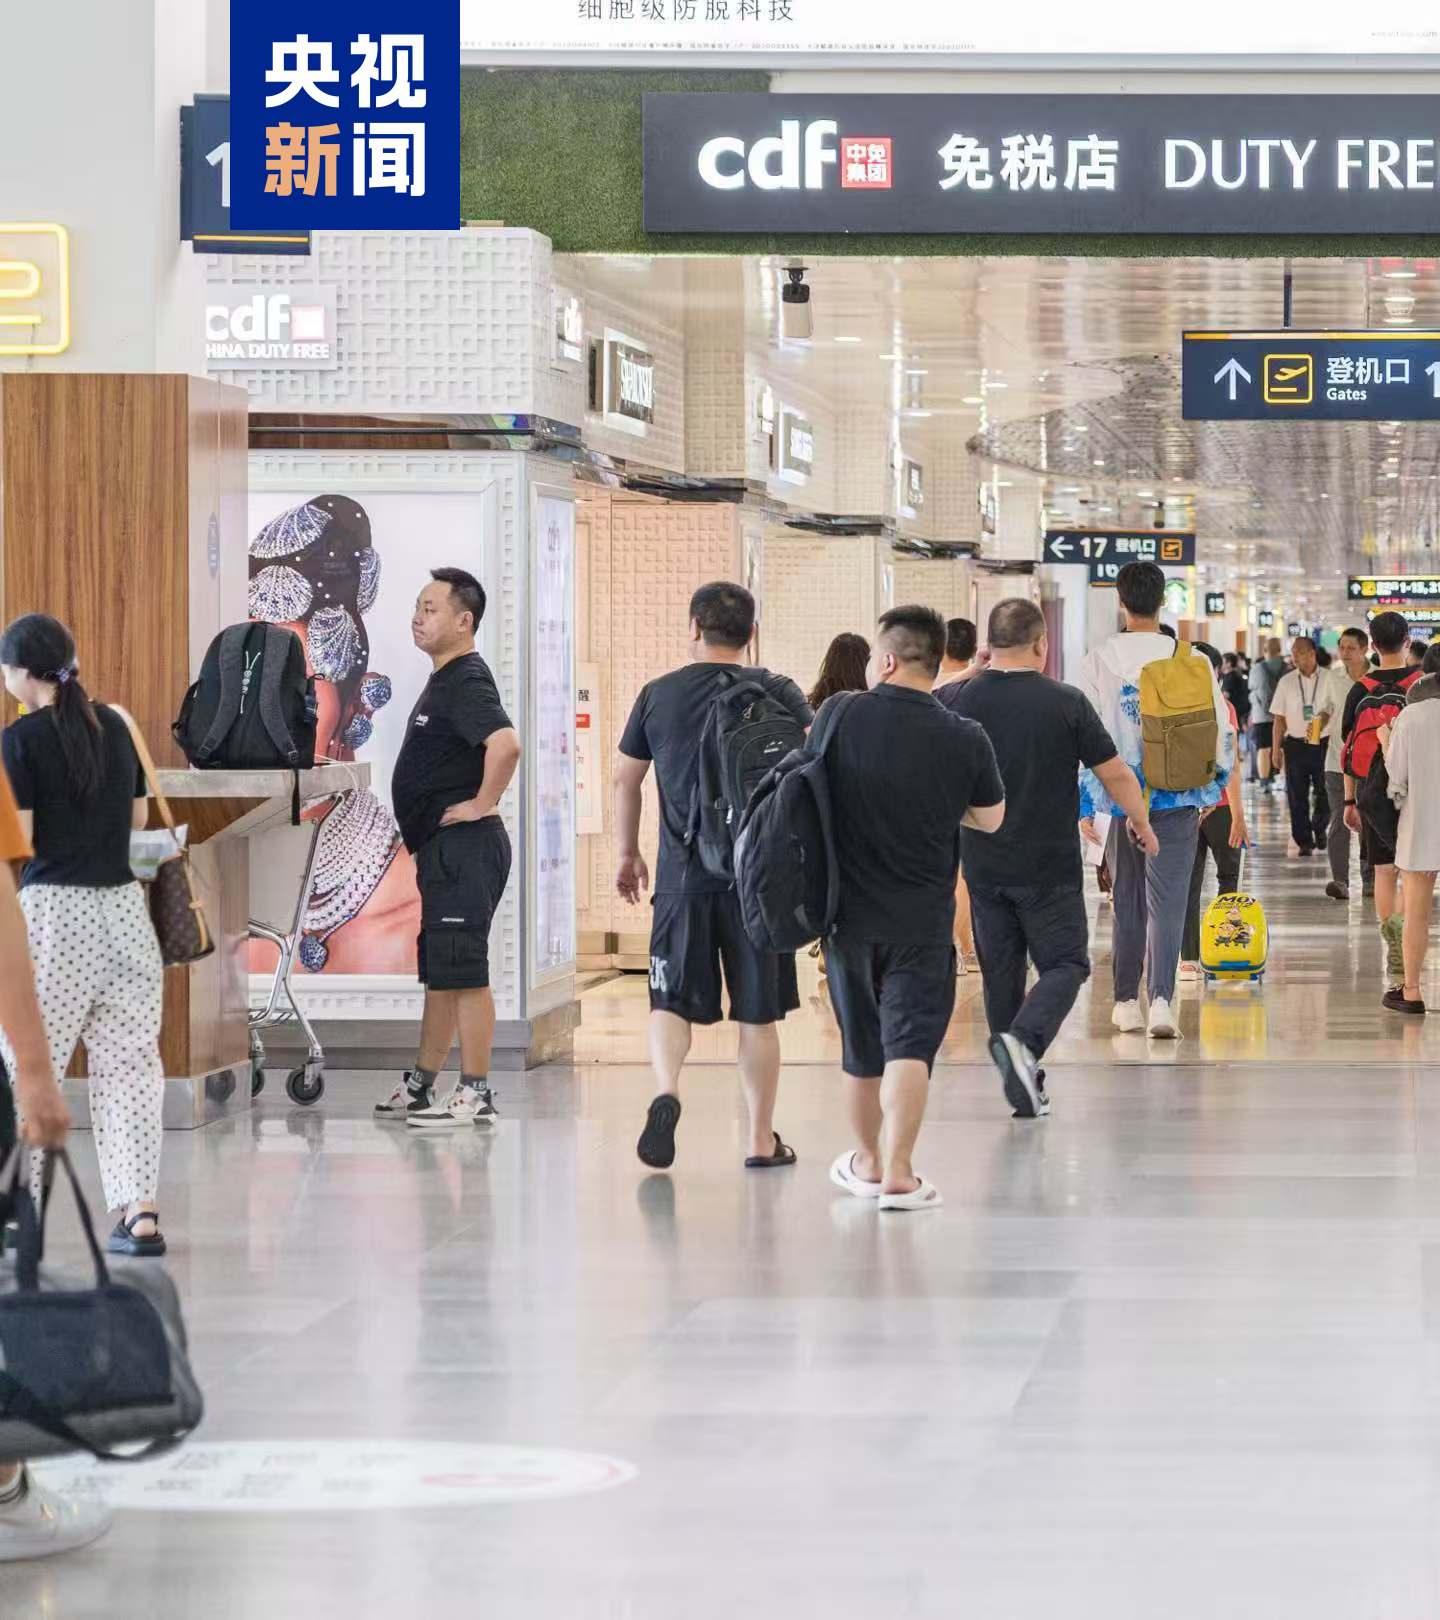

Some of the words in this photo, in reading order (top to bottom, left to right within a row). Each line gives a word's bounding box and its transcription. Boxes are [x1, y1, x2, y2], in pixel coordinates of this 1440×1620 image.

[577, 0, 794, 22] 细胞级防脱科技
[698, 119, 837, 190] cdf
[847, 143, 887, 162] 中免
[937, 133, 1120, 191] 免税店
[1164, 139, 1317, 190] DUTY
[206, 295, 290, 341] cdf
[206, 344, 245, 358] HINA
[249, 344, 290, 358] DUTY
[293, 344, 329, 358] FREE
[1326, 357, 1410, 386] 登机口
[1326, 387, 1367, 401] Gates
[1080, 537, 1108, 558] 17
[1115, 538, 1156, 553] 登机口
